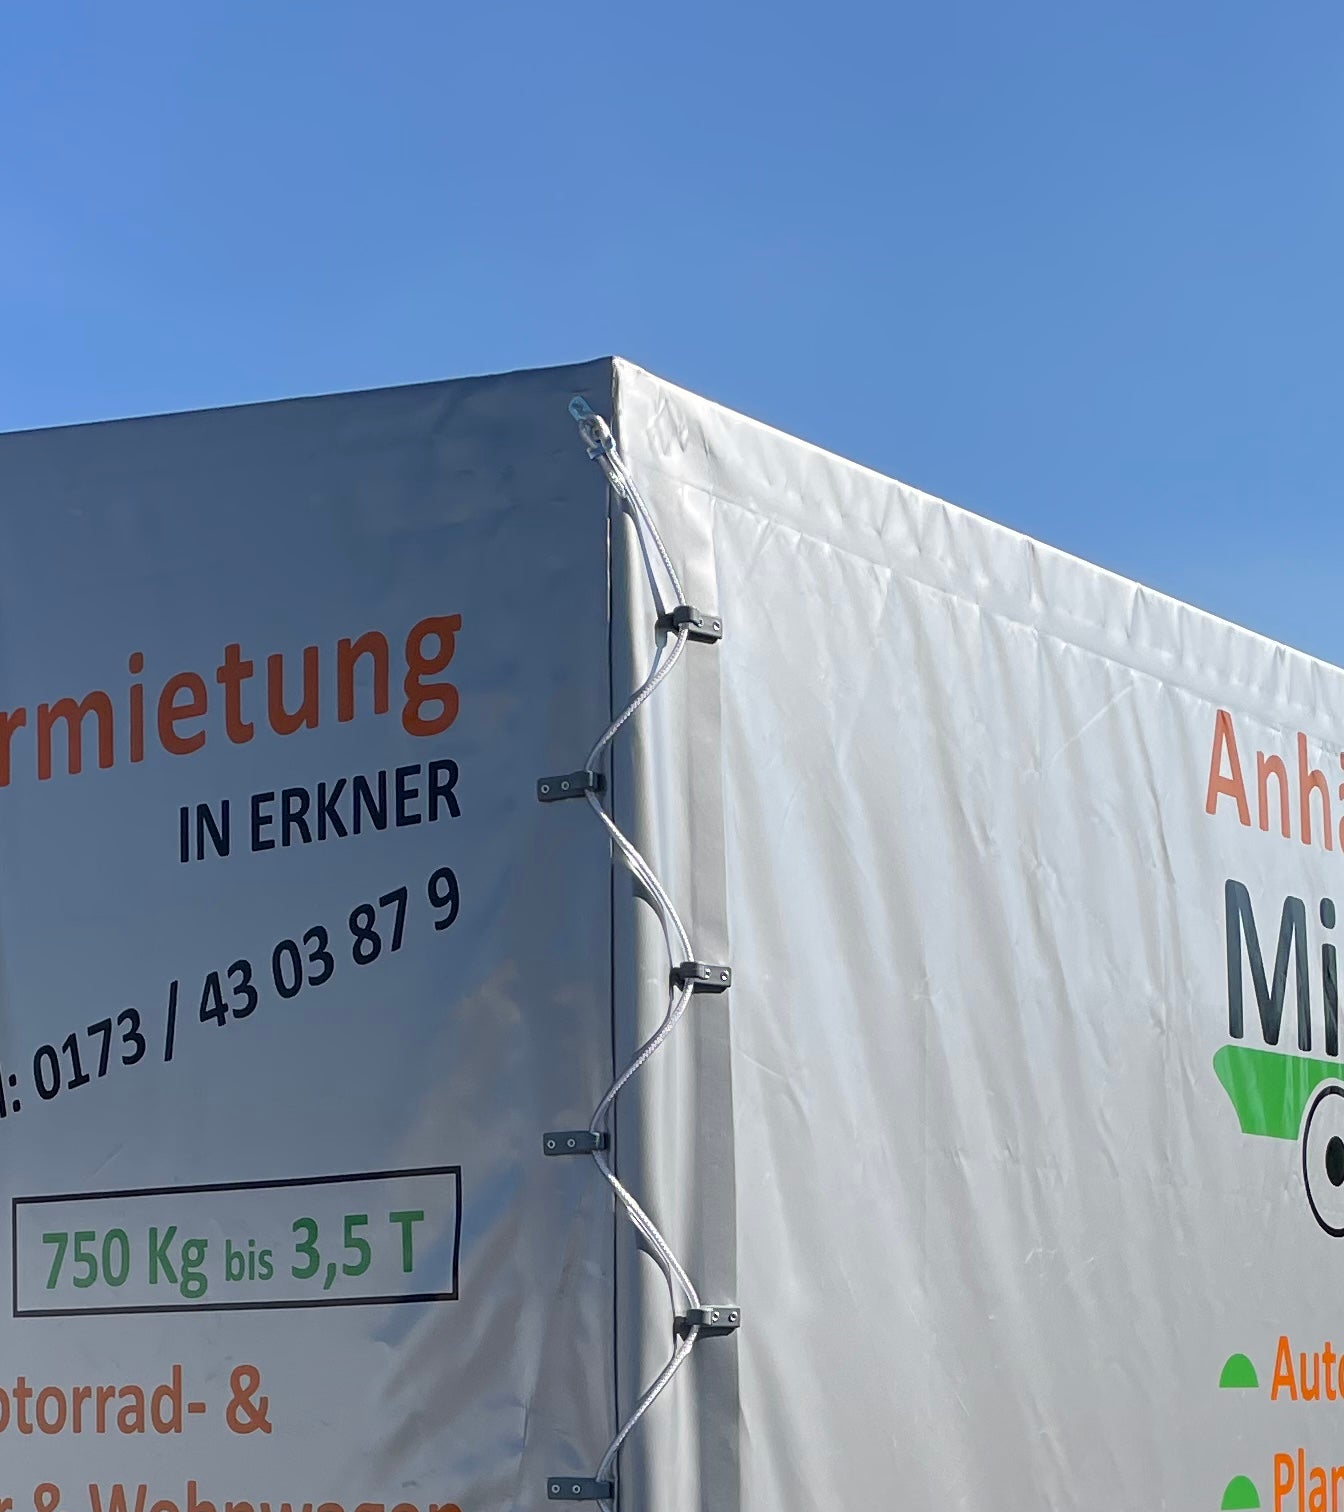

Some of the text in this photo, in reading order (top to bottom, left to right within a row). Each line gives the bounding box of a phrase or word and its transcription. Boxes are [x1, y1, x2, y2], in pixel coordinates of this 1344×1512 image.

[179, 758, 460, 863] IN ERKNER
[31, 1011, 146, 1101] 0173
[163, 981, 180, 1062] /
[198, 965, 259, 1031] 43
[270, 924, 334, 1000] 03
[349, 886, 410, 966] 87
[427, 866, 460, 932] 9
[42, 1209, 425, 1299] 750 Kg bis 3,5 T
[225, 1364, 273, 1436] &
